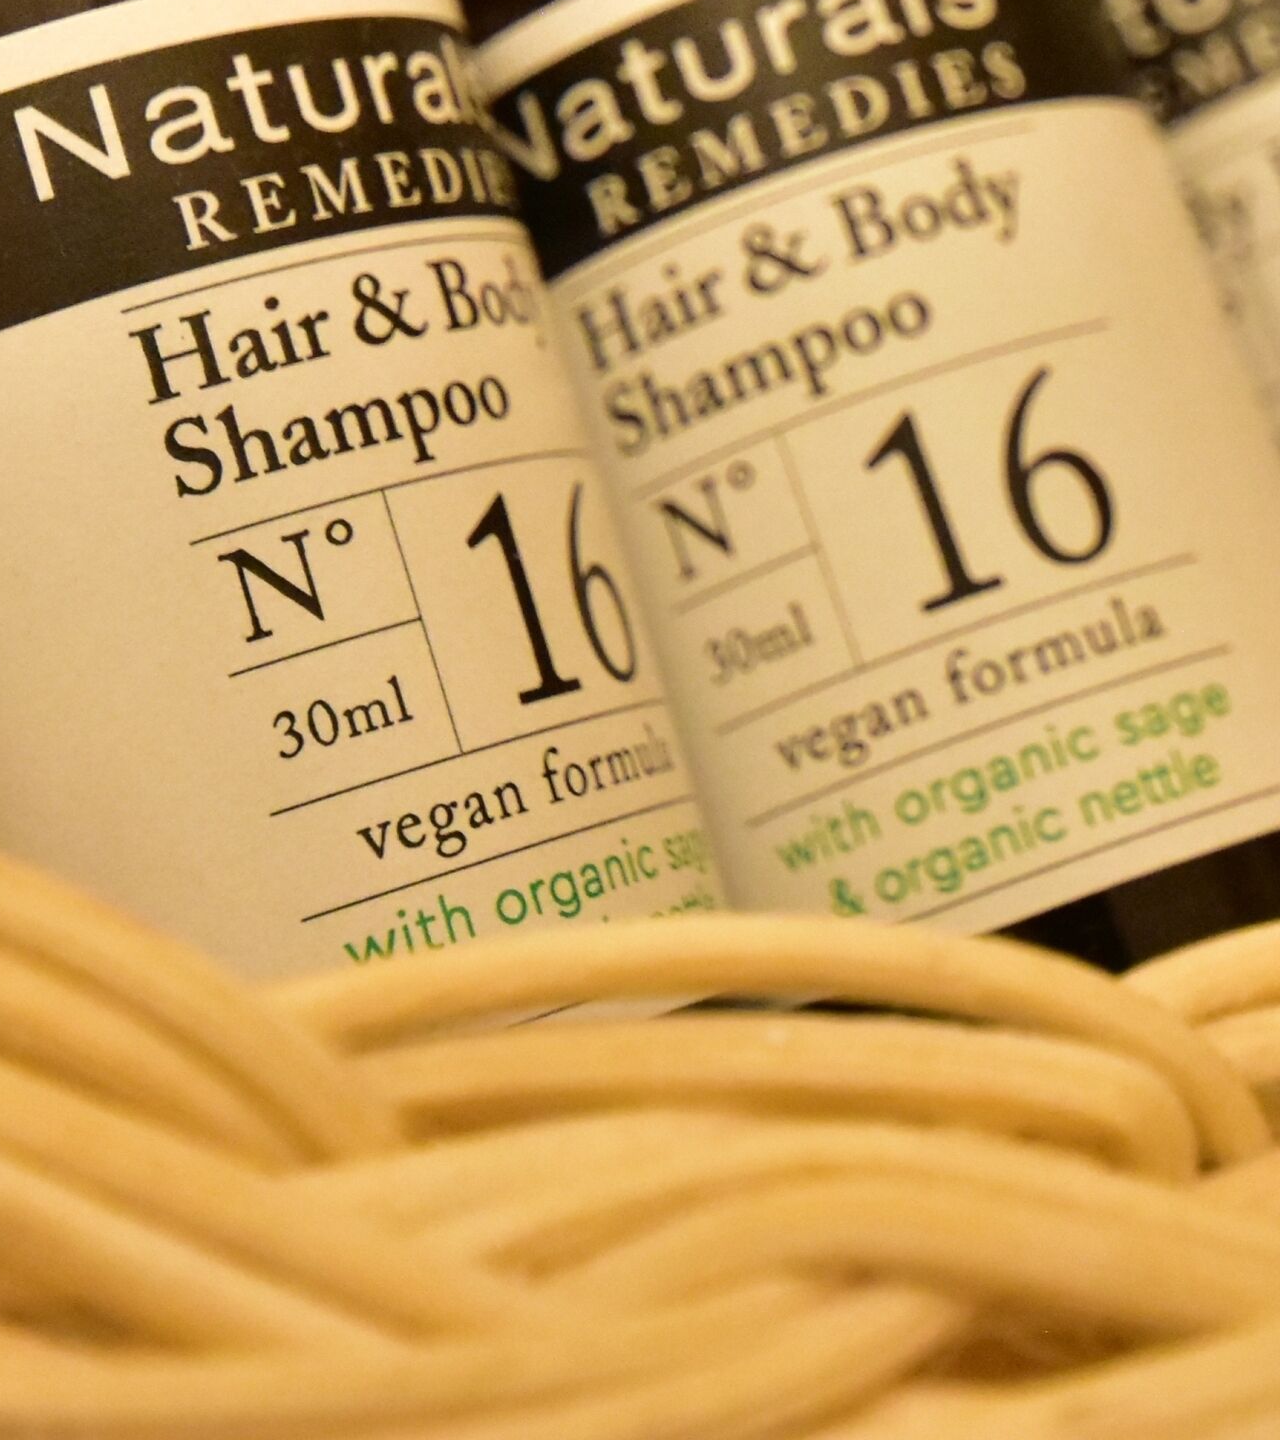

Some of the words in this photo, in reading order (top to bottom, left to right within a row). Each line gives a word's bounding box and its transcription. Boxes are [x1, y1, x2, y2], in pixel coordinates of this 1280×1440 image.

[14, 34, 472, 201] Natural
[584, 41, 1027, 236] REMEDIES
[129, 297, 330, 404] Hair
[352, 272, 428, 346] &
[576, 255, 725, 373] Hair
[739, 221, 830, 297] &
[831, 154, 1022, 262] Body
[164, 374, 509, 498] Shampoo
[603, 289, 934, 457] Shampoo
[865, 365, 1118, 613] 16
[467, 481, 637, 705] 16
[704, 601, 815, 686] 30ml
[272, 674, 414, 760] 30ml
[772, 687, 930, 772] vegan
[944, 596, 1168, 707] formula
[356, 778, 529, 859] vegan
[775, 799, 883, 875] with
[894, 723, 1102, 817] organic
[1117, 682, 1232, 747] sage
[827, 876, 867, 918] &
[873, 805, 1067, 895] organic
[1080, 750, 1222, 828] nettle
[344, 895, 476, 963] with
[495, 837, 658, 925] organic
